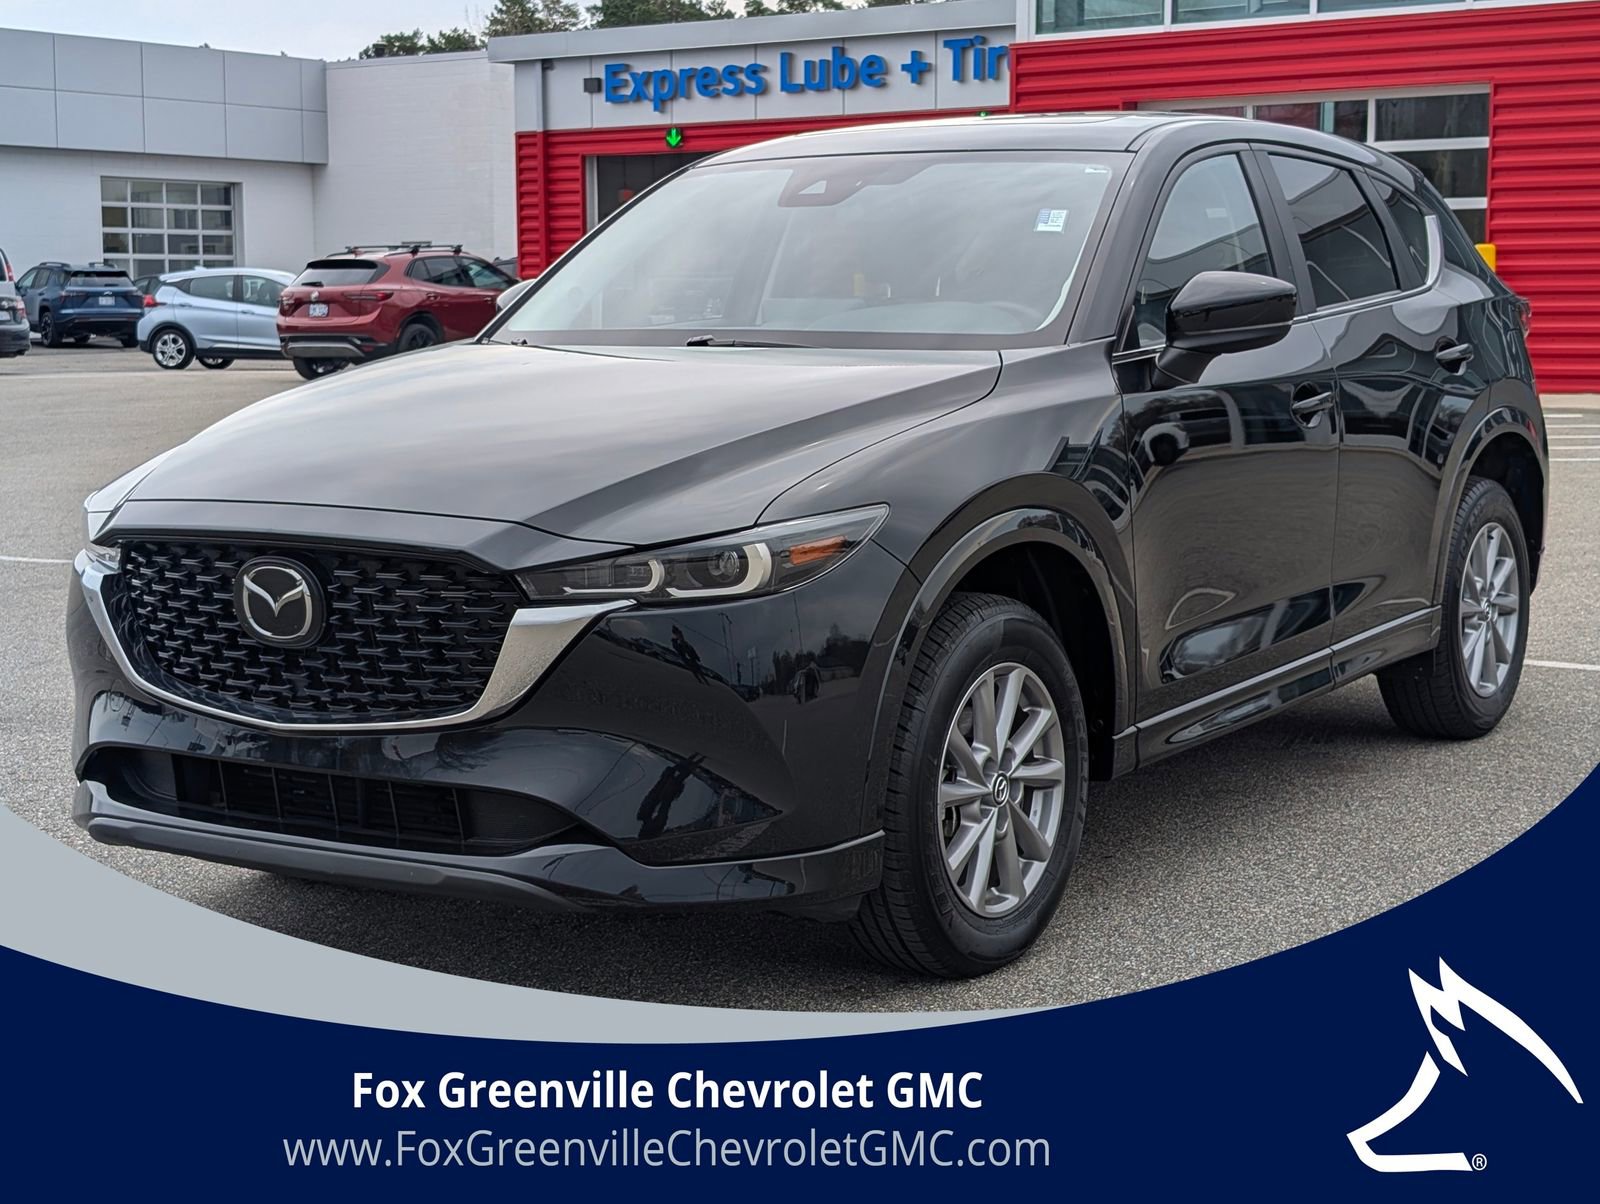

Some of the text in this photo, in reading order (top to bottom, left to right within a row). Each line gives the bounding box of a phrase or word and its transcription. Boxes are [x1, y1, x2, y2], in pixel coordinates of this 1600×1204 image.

[604, 35, 1010, 112] Express Lube + Tir
